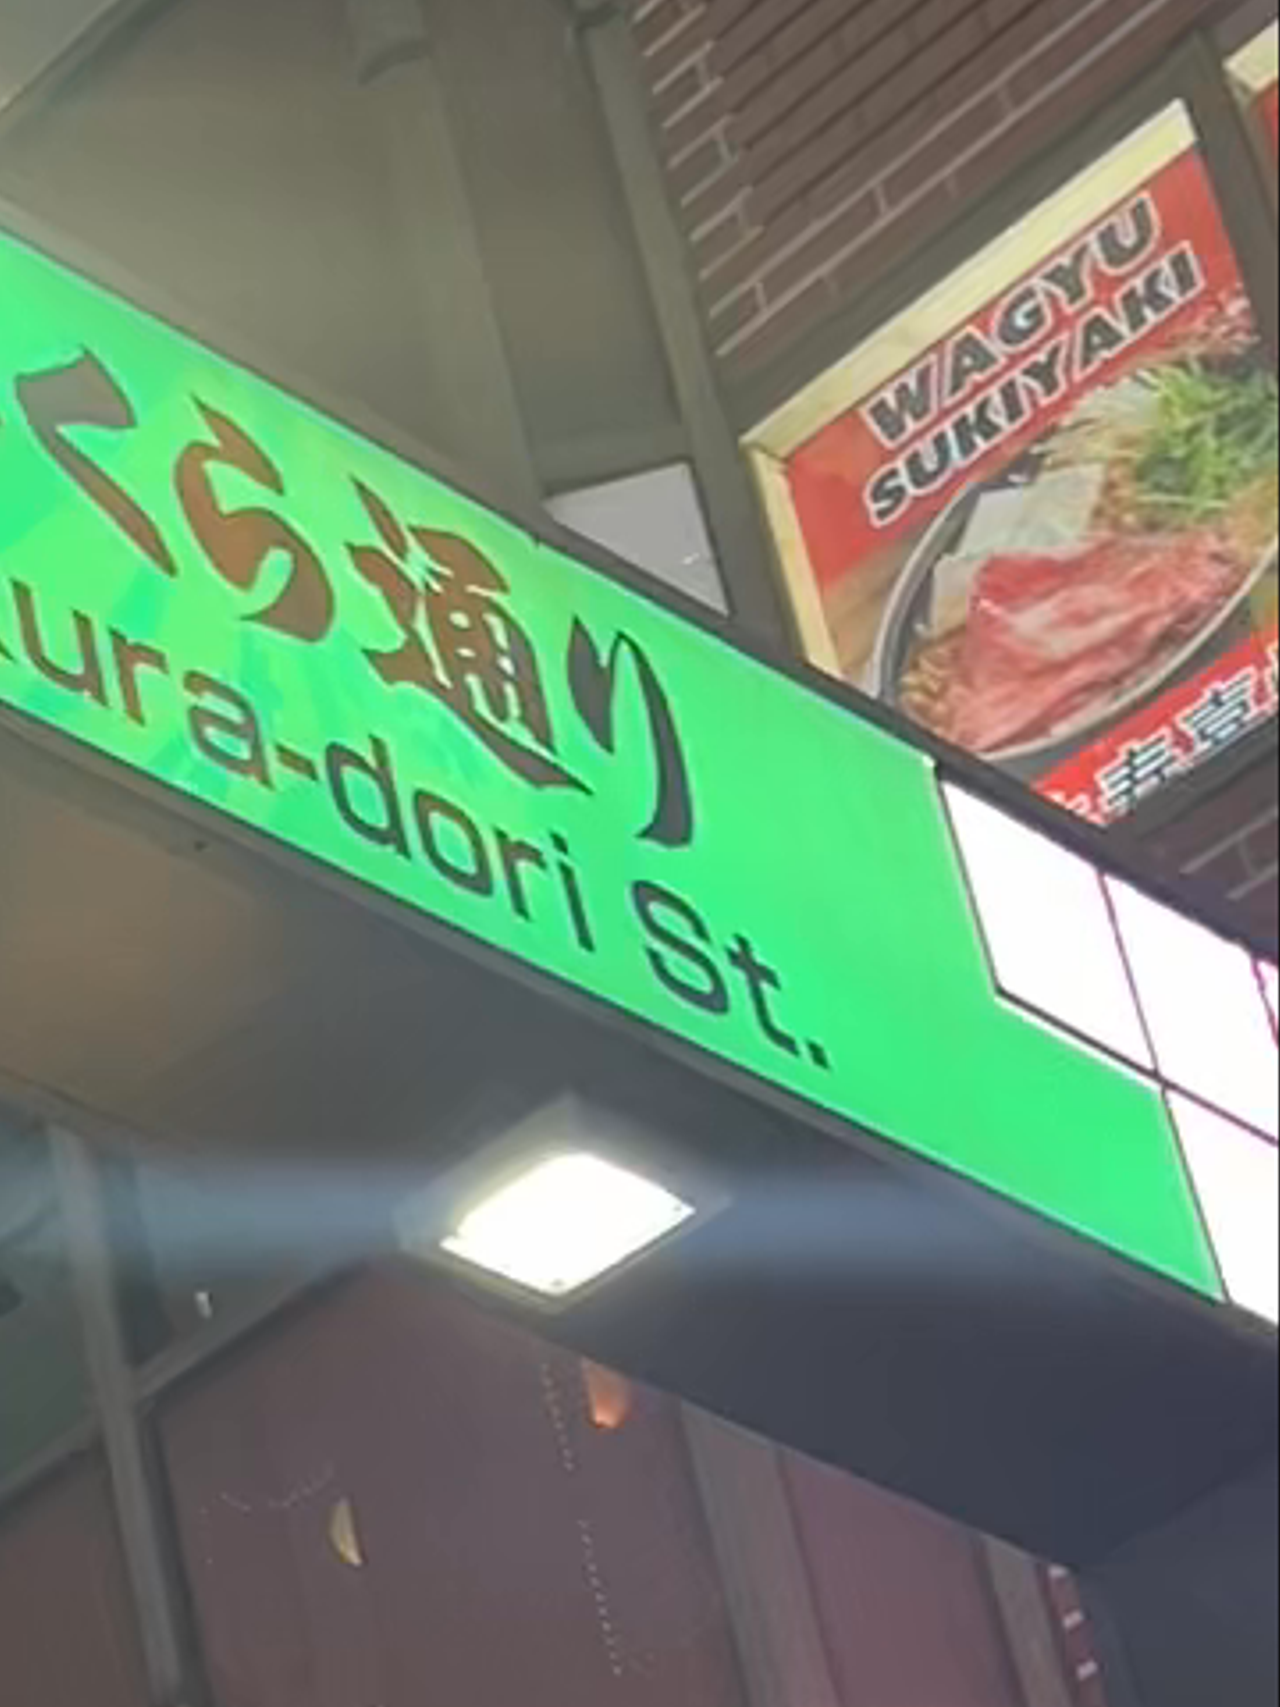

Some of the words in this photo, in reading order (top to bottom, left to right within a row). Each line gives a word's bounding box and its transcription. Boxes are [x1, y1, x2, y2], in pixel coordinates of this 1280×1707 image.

[864, 193, 1159, 446] WAGYU
[865, 242, 1203, 525] SUKIYAKI
[630, 881, 830, 1071] St.
